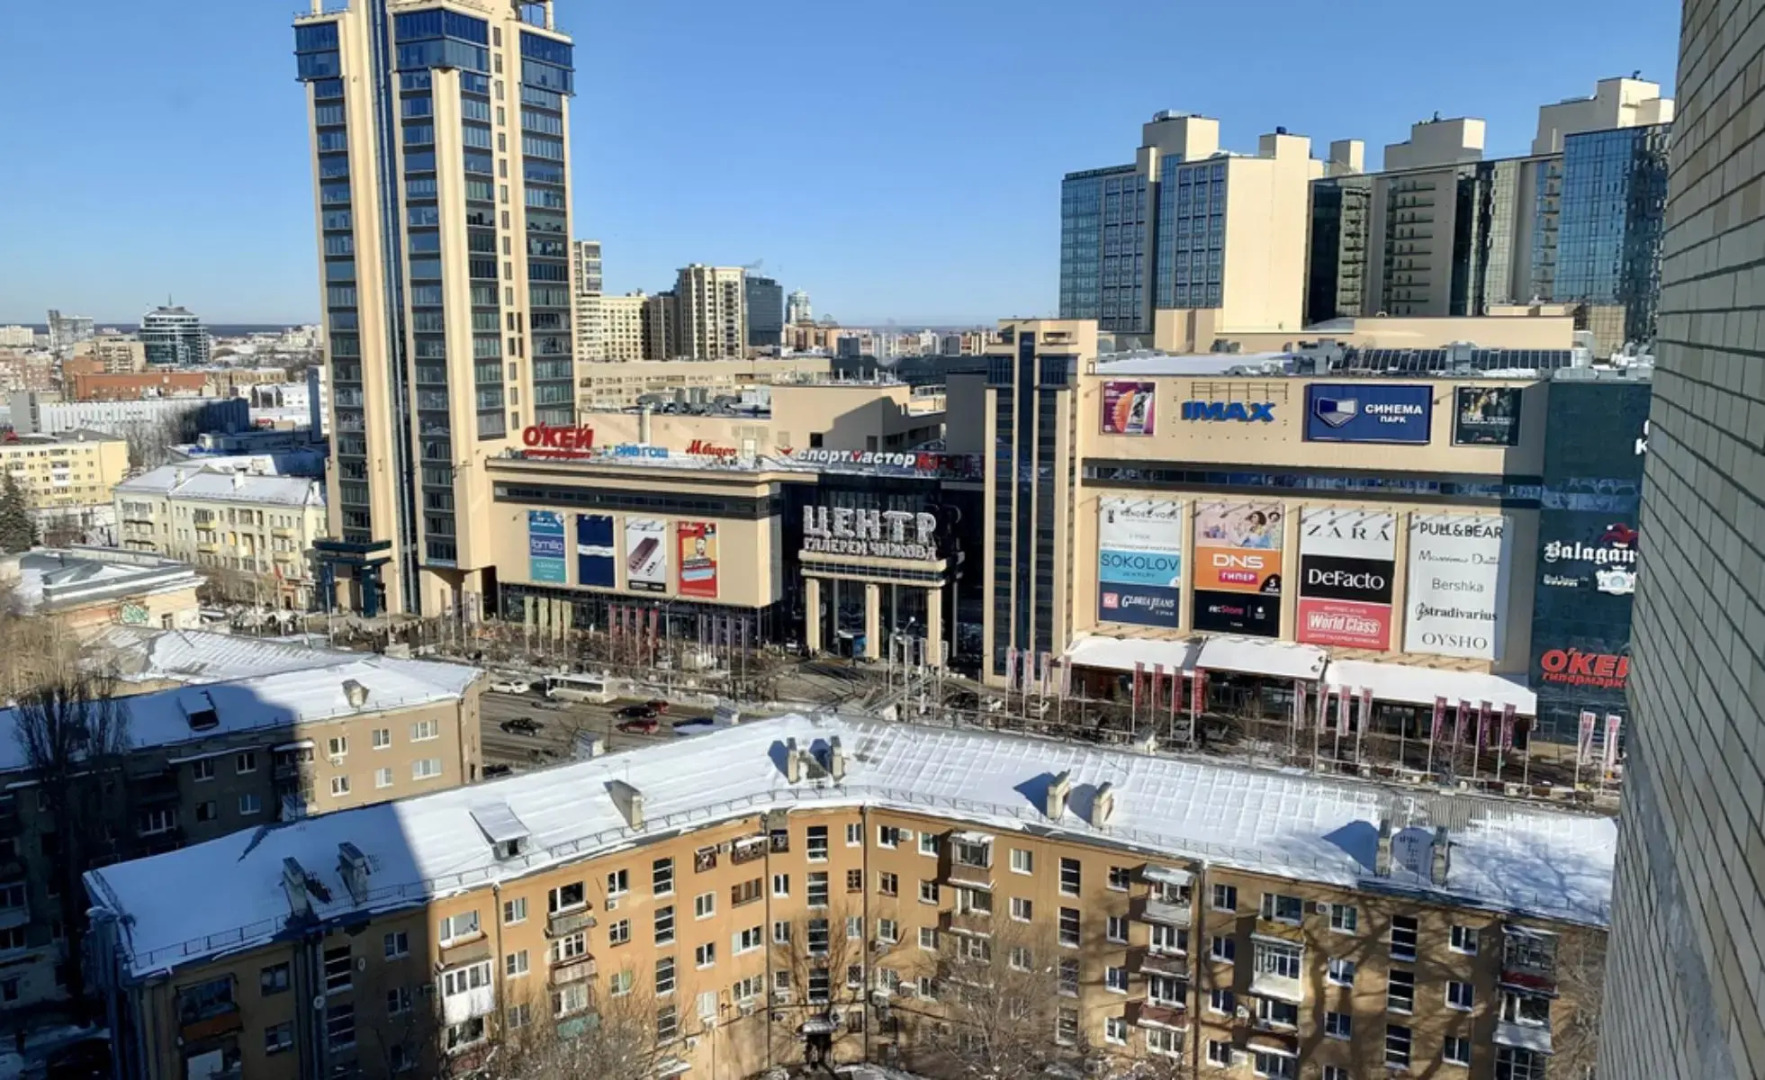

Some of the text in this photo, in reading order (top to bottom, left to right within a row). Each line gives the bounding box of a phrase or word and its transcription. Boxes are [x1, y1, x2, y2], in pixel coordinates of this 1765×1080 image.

[1181, 400, 1276, 422] IMAX
[1365, 403, 1423, 416] СИНЕМА
[1380, 415, 1407, 424] ПАРК
[522, 421, 594, 449] О'КЕЙ
[803, 504, 937, 544] ЦЕНТР
[1307, 523, 1391, 541] ZARA
[1420, 521, 1503, 539] PULL&BEAR
[869, 541, 937, 562] ЧИЖОВА
[1101, 552, 1179, 572] SOKOLOV
[1212, 553, 1264, 569] DNS
[1222, 572, 1255, 581] ГИПЕР
[1308, 568, 1385, 590] DeFacto
[1431, 577, 1484, 593] Bershka
[1310, 614, 1378, 634] World Class
[1421, 632, 1488, 650] OYSHO
[1543, 672, 1628, 688] гипермарк
